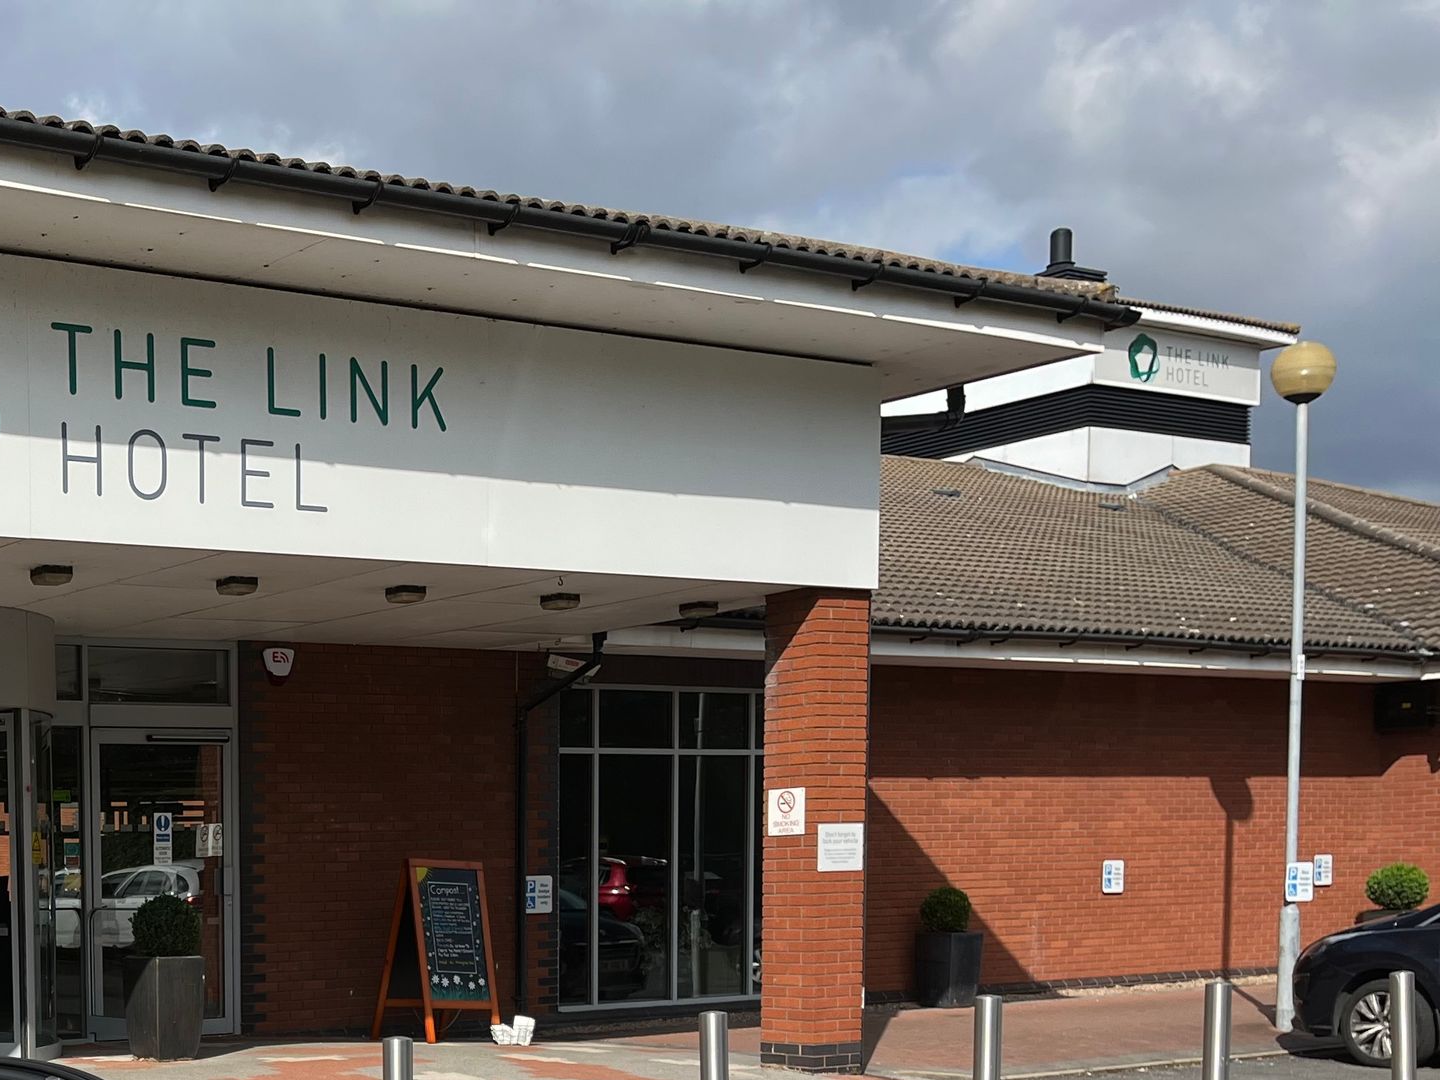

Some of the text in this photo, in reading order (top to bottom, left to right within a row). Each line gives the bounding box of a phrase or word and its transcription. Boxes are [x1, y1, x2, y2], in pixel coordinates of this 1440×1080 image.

[1166, 346, 1230, 369] THE LINK
[50, 321, 447, 433] THE LINK
[1166, 366, 1208, 387] HOTEL
[61, 421, 328, 513] HOTEL
[527, 881, 535, 893] P
